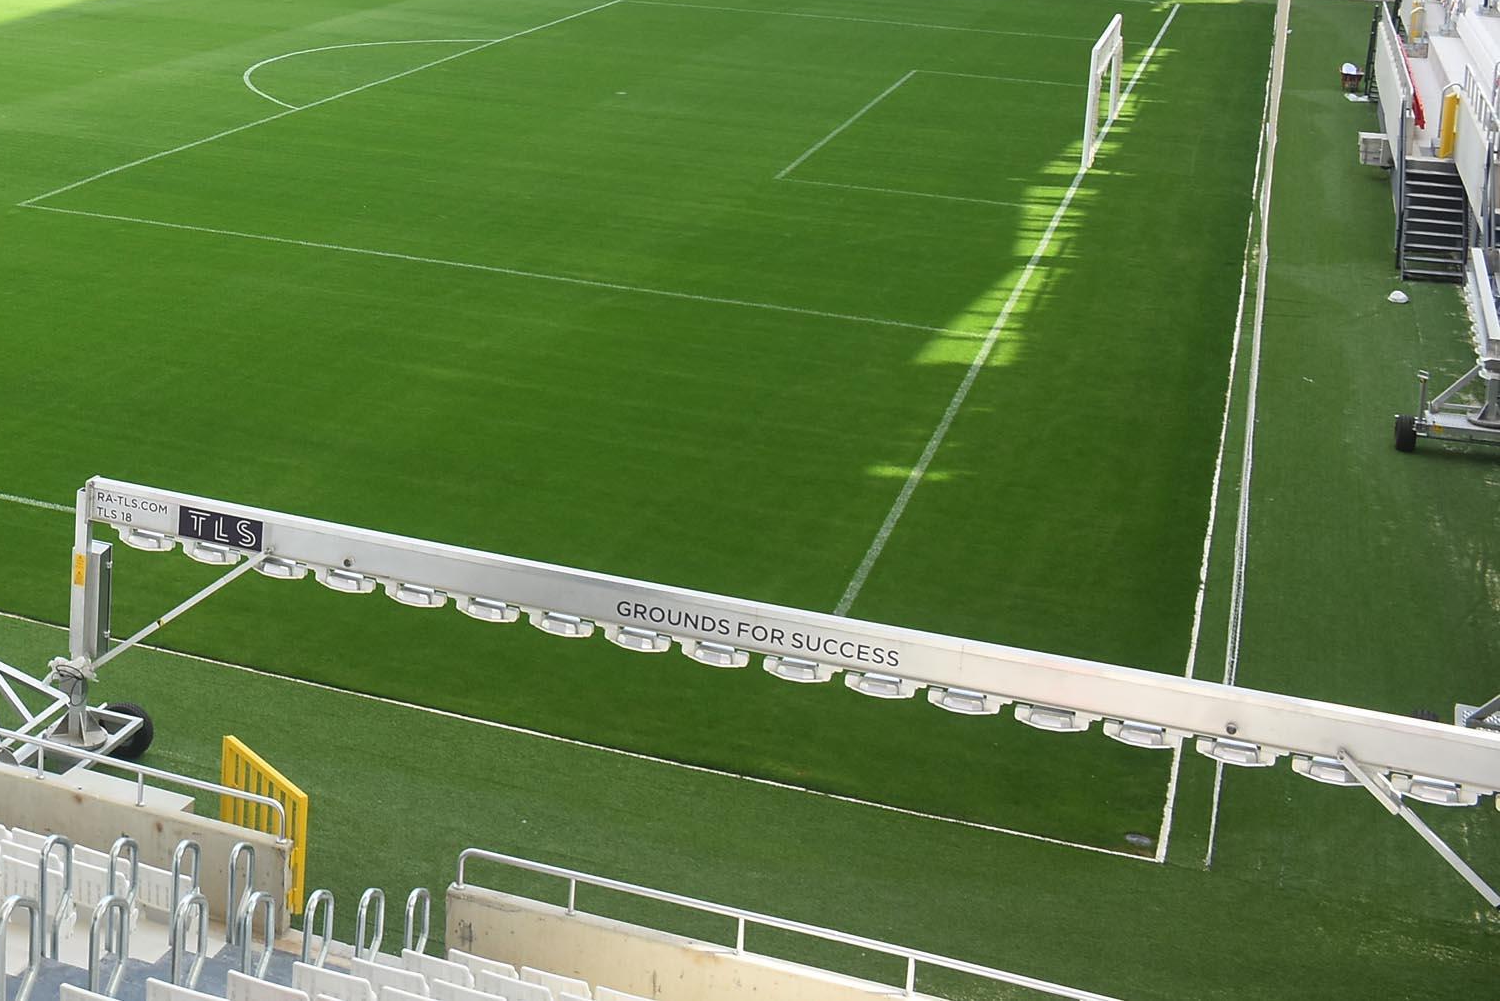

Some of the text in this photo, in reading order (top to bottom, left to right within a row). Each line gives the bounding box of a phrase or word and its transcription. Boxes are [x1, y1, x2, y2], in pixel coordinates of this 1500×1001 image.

[97, 492, 168, 515] RA-TLS.COM
[97, 506, 132, 523] TLS 18
[188, 510, 256, 547] TLS
[616, 601, 899, 667] GROUNDS FOR SUCCESS
